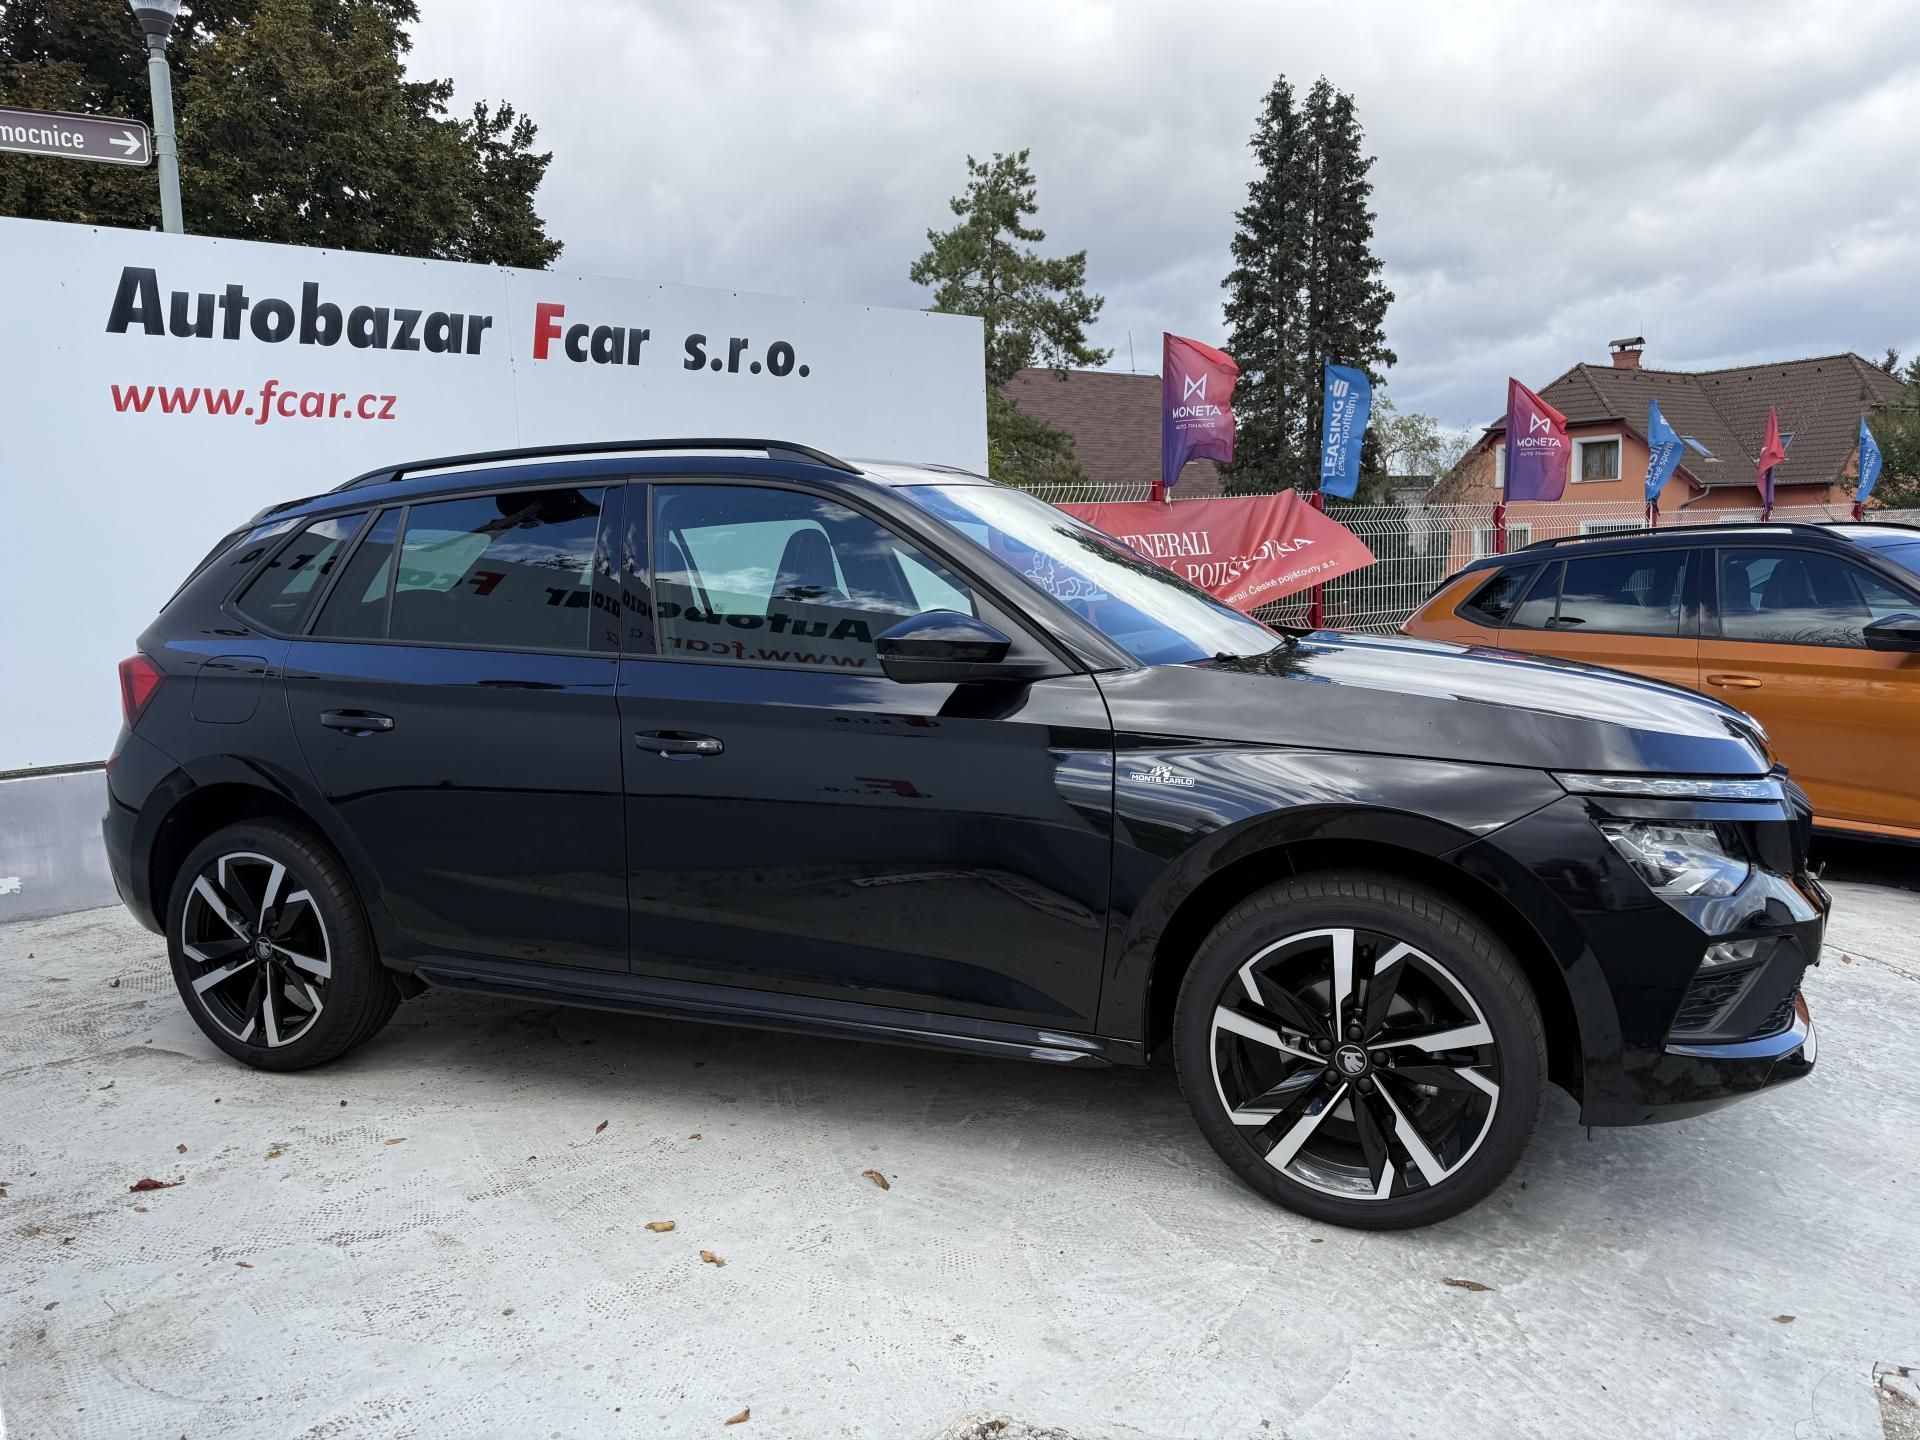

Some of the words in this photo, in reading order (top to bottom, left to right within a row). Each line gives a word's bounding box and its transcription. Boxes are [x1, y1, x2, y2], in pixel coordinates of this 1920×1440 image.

[0, 124, 85, 149] mocnice
[105, 266, 493, 355] Autobazar
[533, 302, 650, 366] Fcar
[683, 333, 810, 378] s.r.o.
[110, 379, 397, 425] www.fcar.cz
[1172, 404, 1222, 419] MONETA
[1323, 399, 1345, 477] LEASING
[1516, 437, 1562, 448] MONETA
[1116, 531, 1212, 558] ENERALI
[1248, 579, 1277, 595] České
[1277, 565, 1321, 585] pojišťovny
[1322, 559, 1339, 569] a.s.
[1131, 774, 1162, 783] MONTE
[1163, 776, 1192, 786] CARLO
